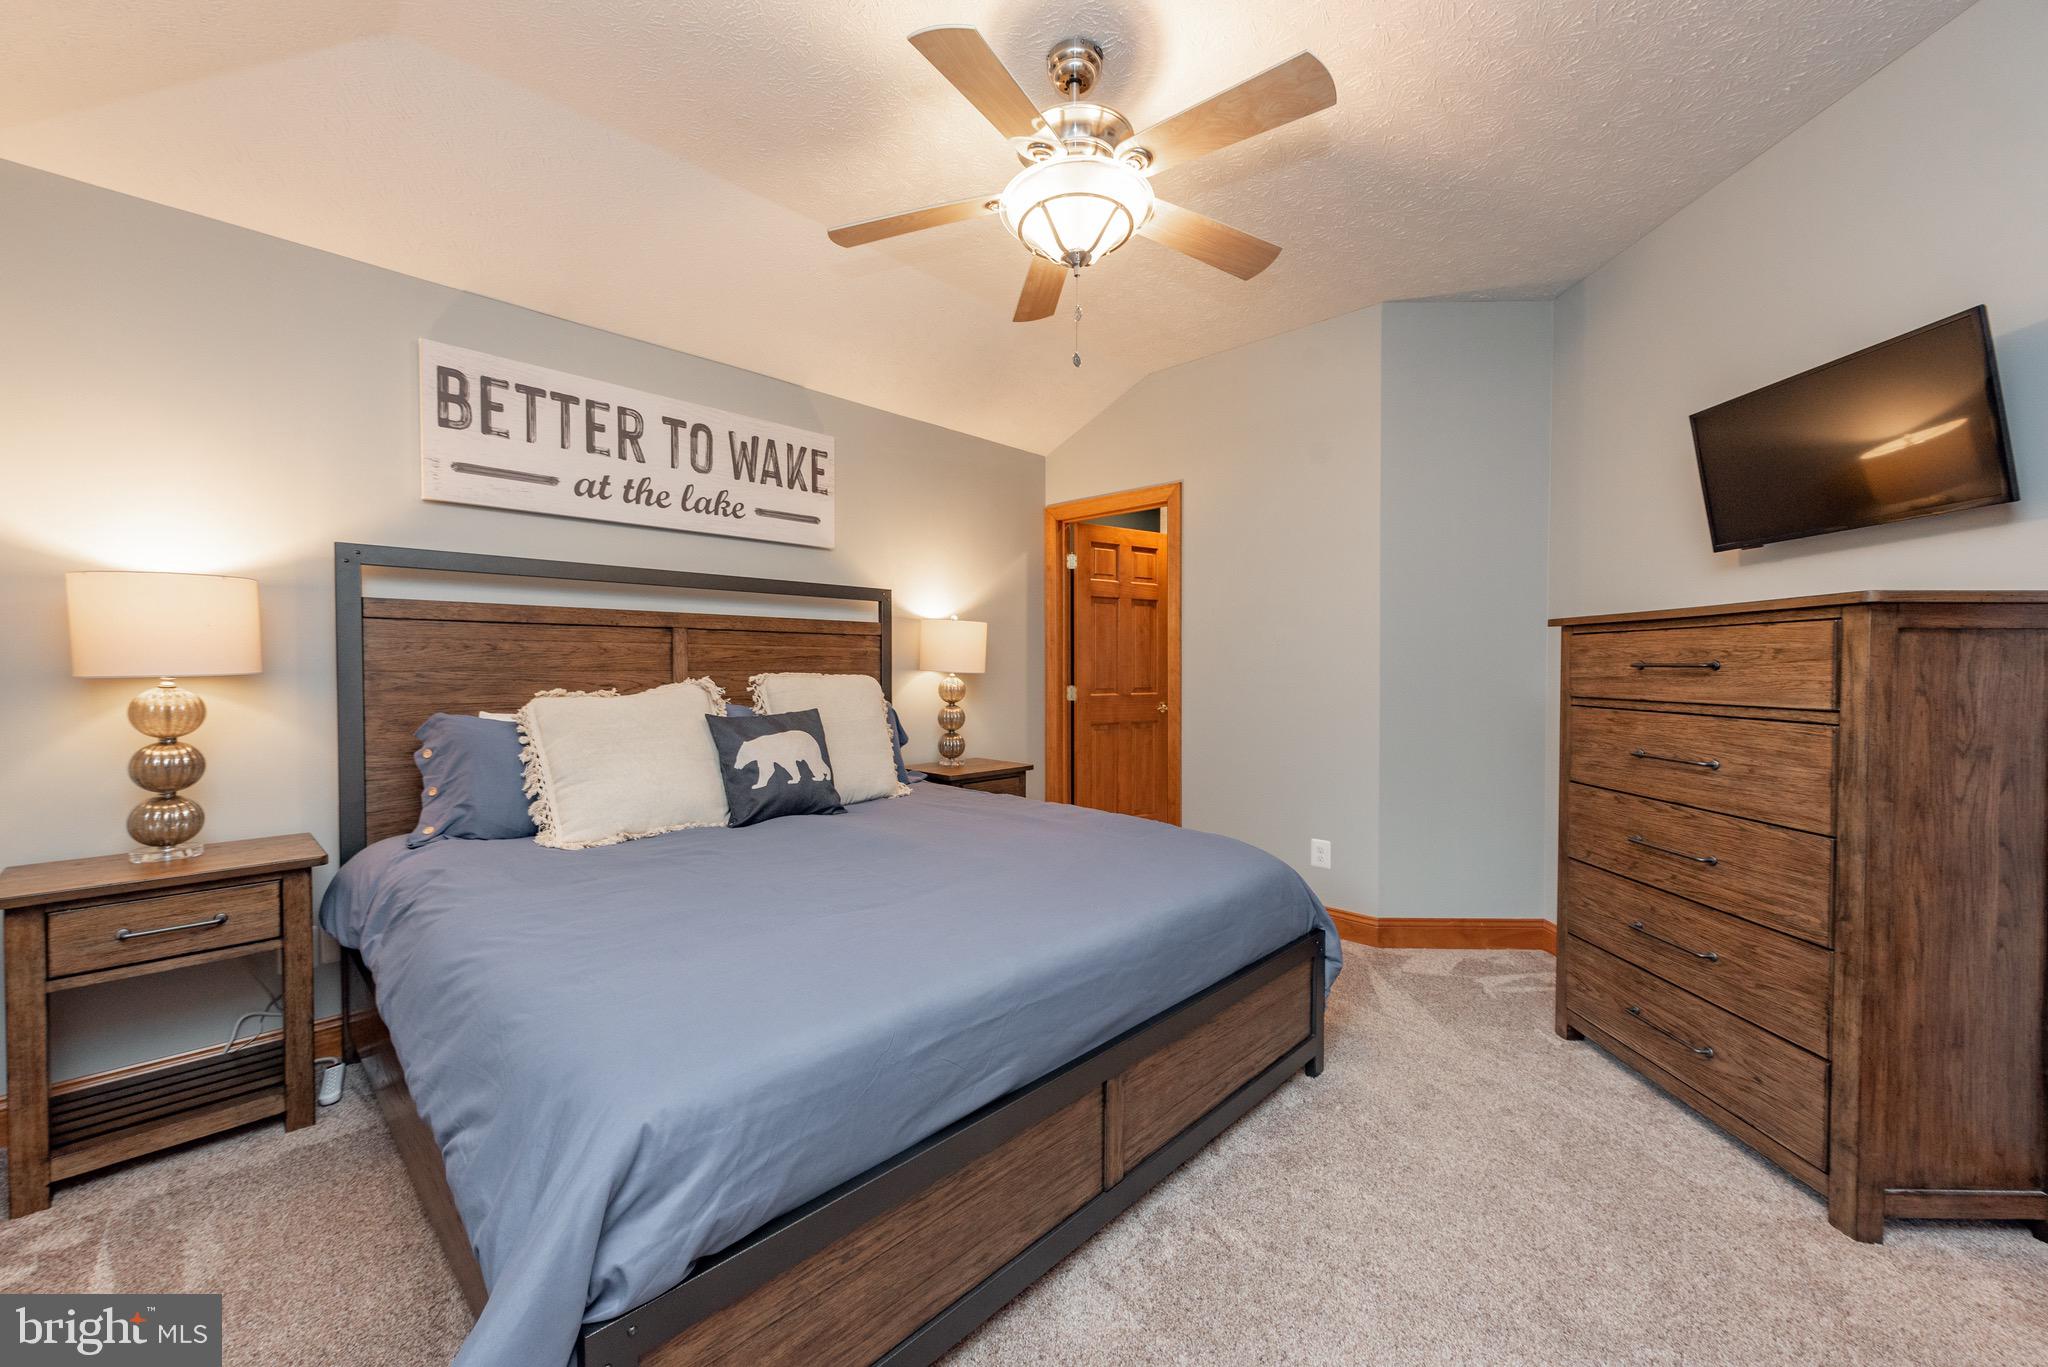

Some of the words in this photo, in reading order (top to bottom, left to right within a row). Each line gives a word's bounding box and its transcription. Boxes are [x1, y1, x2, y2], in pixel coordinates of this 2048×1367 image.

[436, 365, 646, 464] BETTER
[661, 415, 714, 474] TO
[728, 430, 829, 496] WAKE
[573, 474, 614, 501] at
[622, 476, 673, 509] the
[680, 483, 747, 520] lake
